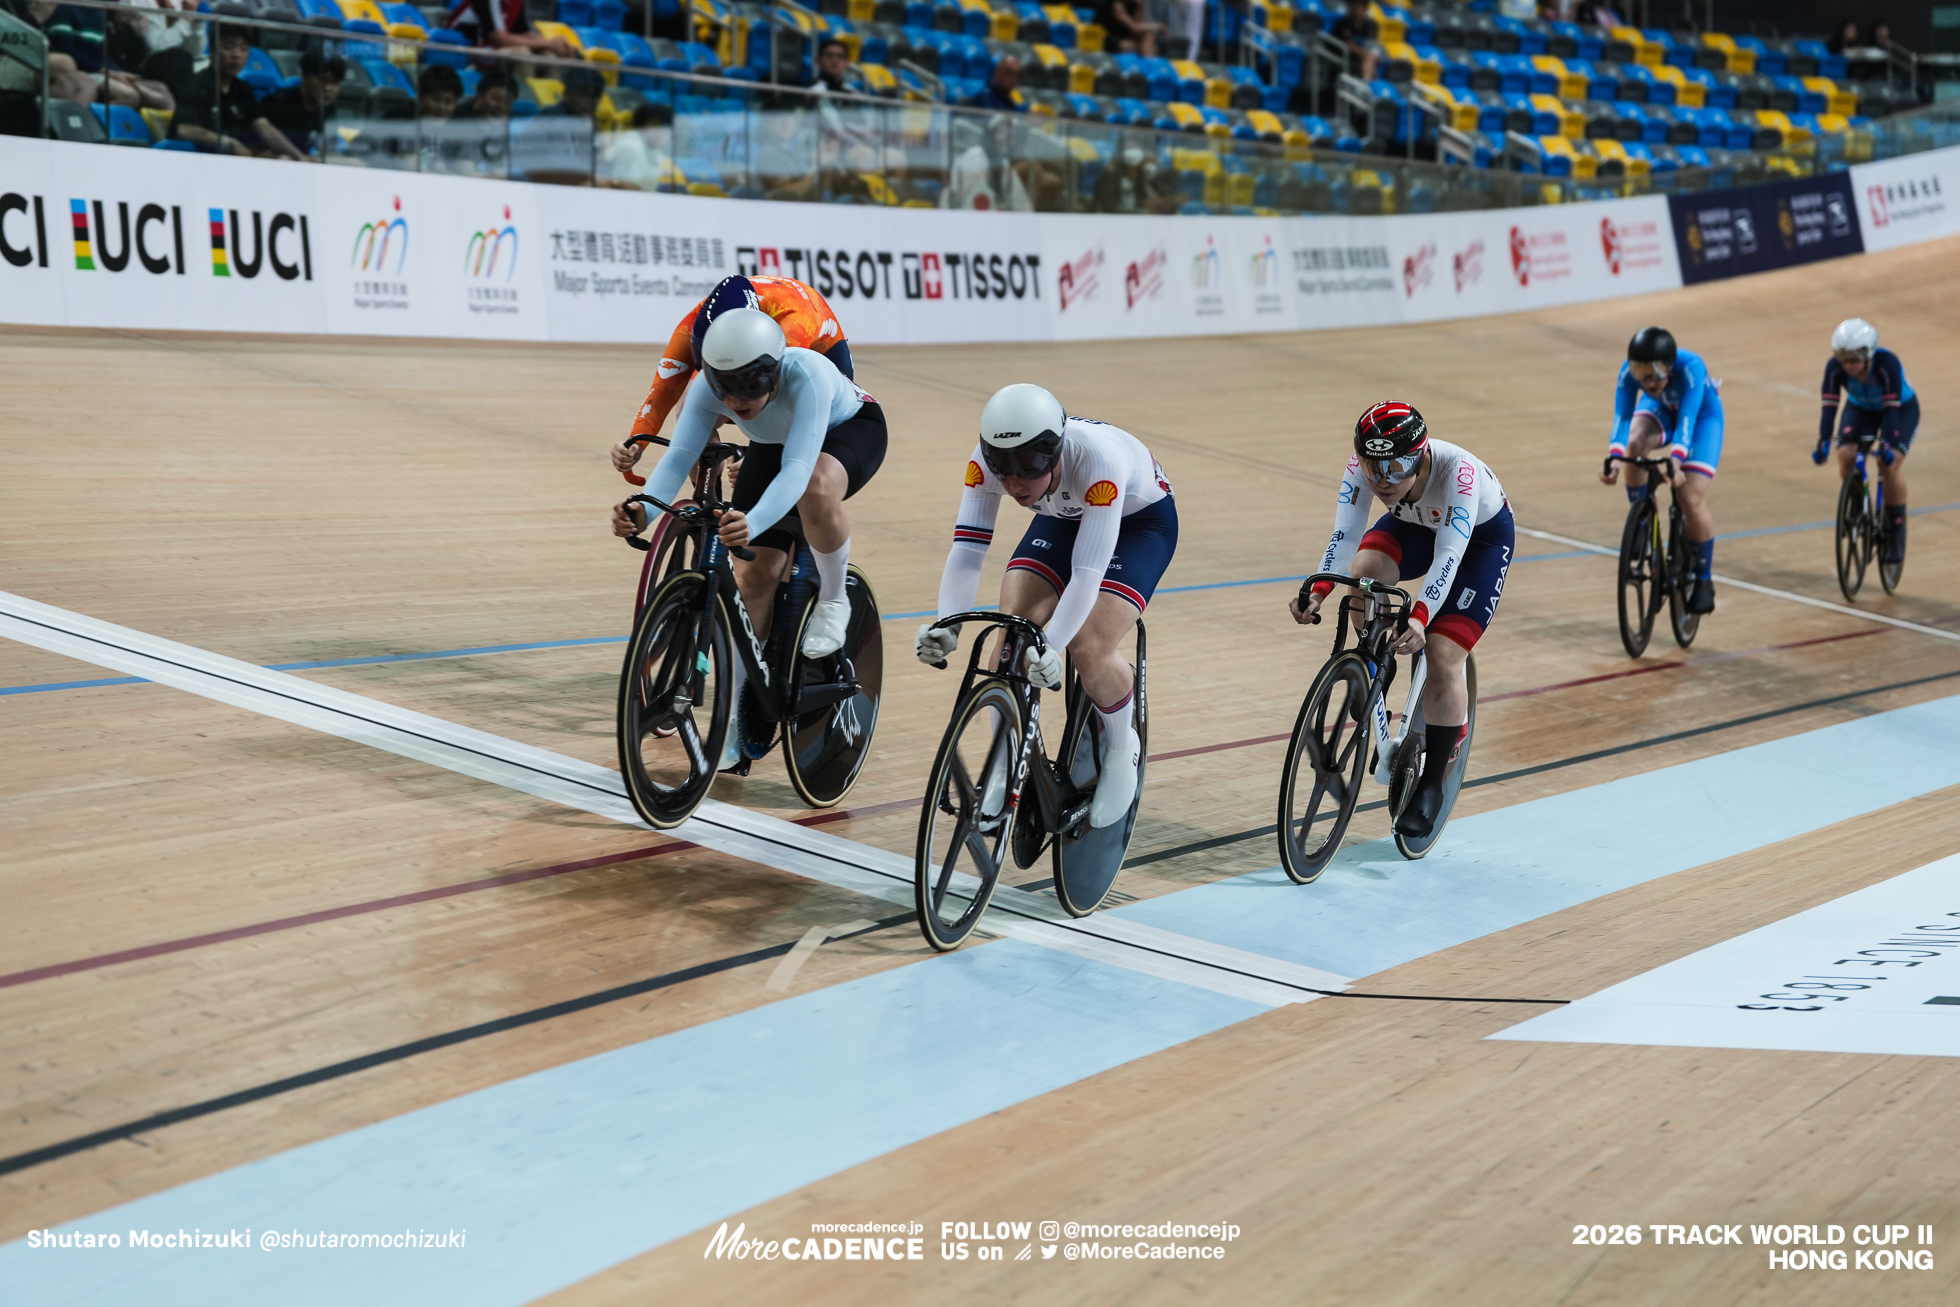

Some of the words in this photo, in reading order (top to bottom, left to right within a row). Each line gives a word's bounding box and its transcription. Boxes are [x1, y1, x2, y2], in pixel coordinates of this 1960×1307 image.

[0, 192, 49, 268] CI
[92, 199, 186, 275] UCI
[229, 209, 313, 281] UCI
[554, 270, 588, 297] Major
[591, 272, 630, 299] Sports
[632, 273, 670, 296] Events
[784, 249, 893, 299] TISSOT
[944, 253, 1040, 299] TISSOT
[703, 467, 712, 494] KOGA
[1444, 505, 1454, 527] KEIRIN
[709, 534, 721, 564] KOGA
[1323, 543, 1337, 572] Cyclers
[1435, 556, 1455, 588] Cyclers
[1484, 545, 1511, 625] JAPAN
[733, 589, 770, 688] KOGA
[1012, 703, 1040, 796] LOTUS
[1833, 924, 1960, 967] SINCE
[1736, 975, 1888, 1011] 1853
